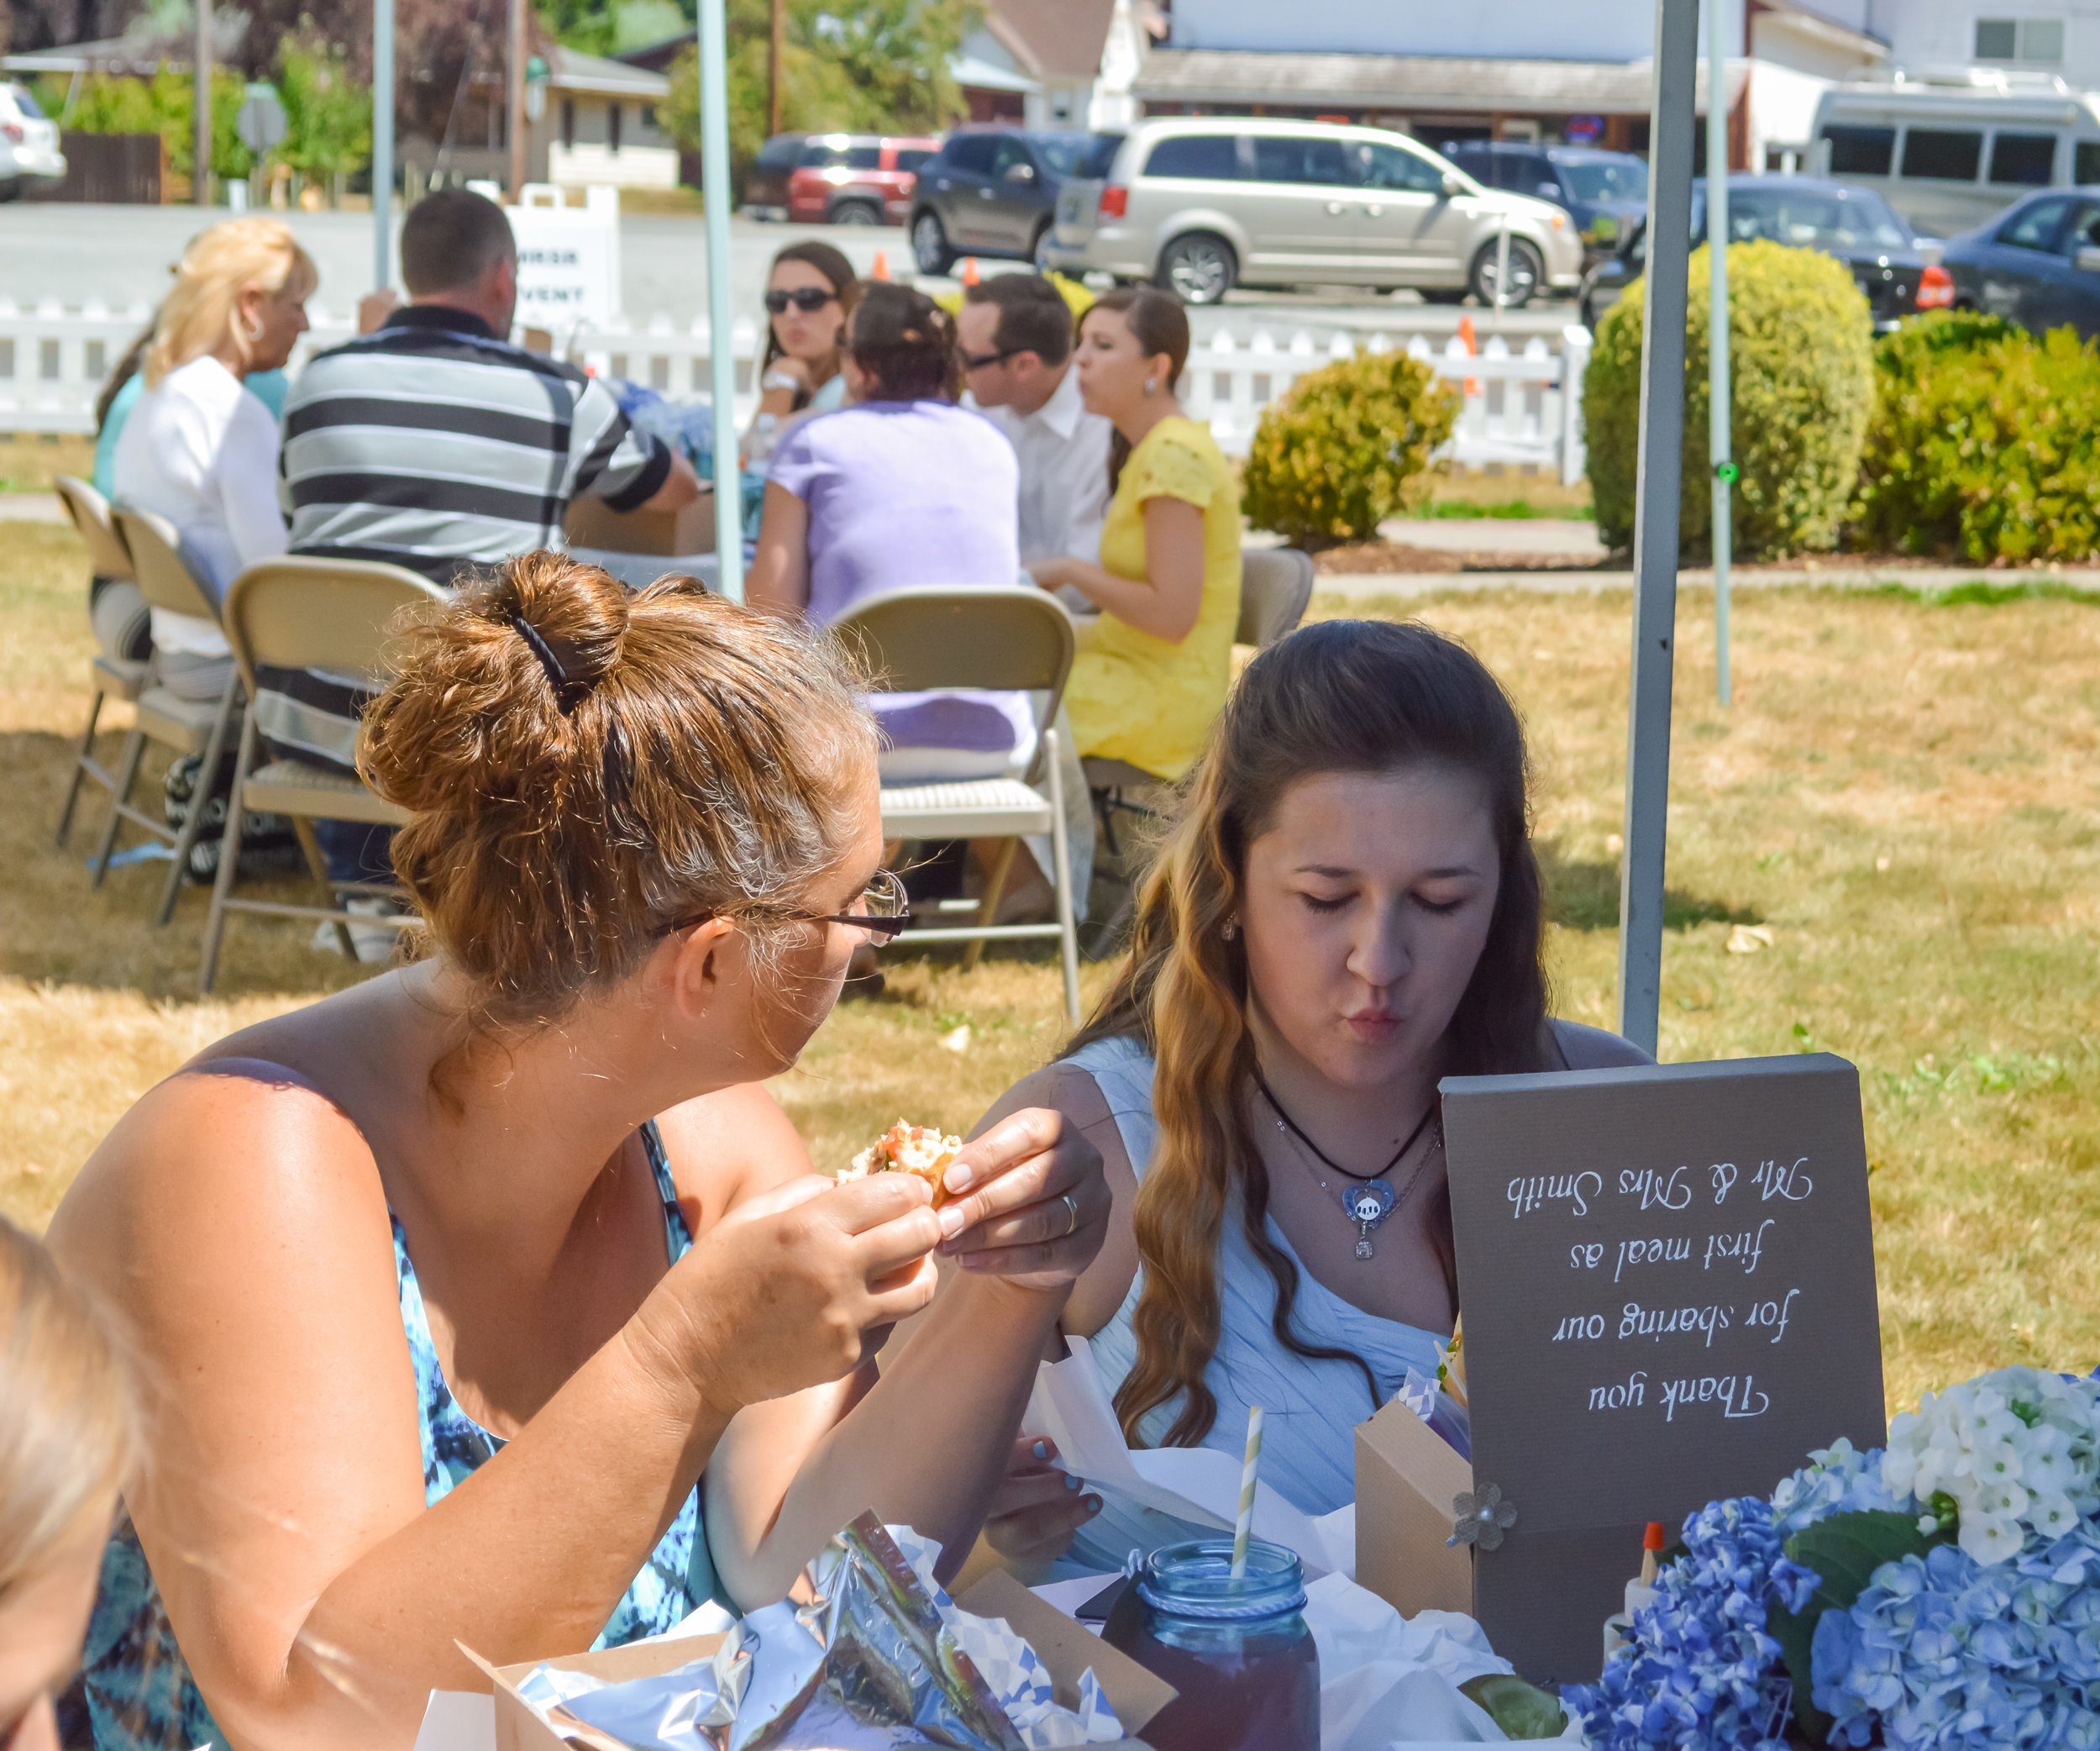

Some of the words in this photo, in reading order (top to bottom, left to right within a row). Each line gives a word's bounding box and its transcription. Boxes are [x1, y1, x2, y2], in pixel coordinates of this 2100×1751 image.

[517, 286, 583, 301] VENT
[1508, 1171, 1602, 1218] Smith
[1620, 1166, 1691, 1210] Mrs
[1709, 1163, 1737, 1204] &
[1751, 1158, 1812, 1201] Mr
[1571, 1244, 1604, 1268] as
[1614, 1238, 1690, 1282] meal
[1704, 1219, 1775, 1274] first
[1552, 1314, 1605, 1341] our
[1619, 1302, 1735, 1347] sharing
[1745, 1289, 1800, 1343] for
[1589, 1371, 1648, 1411] you
[1660, 1375, 1768, 1422] Thank
